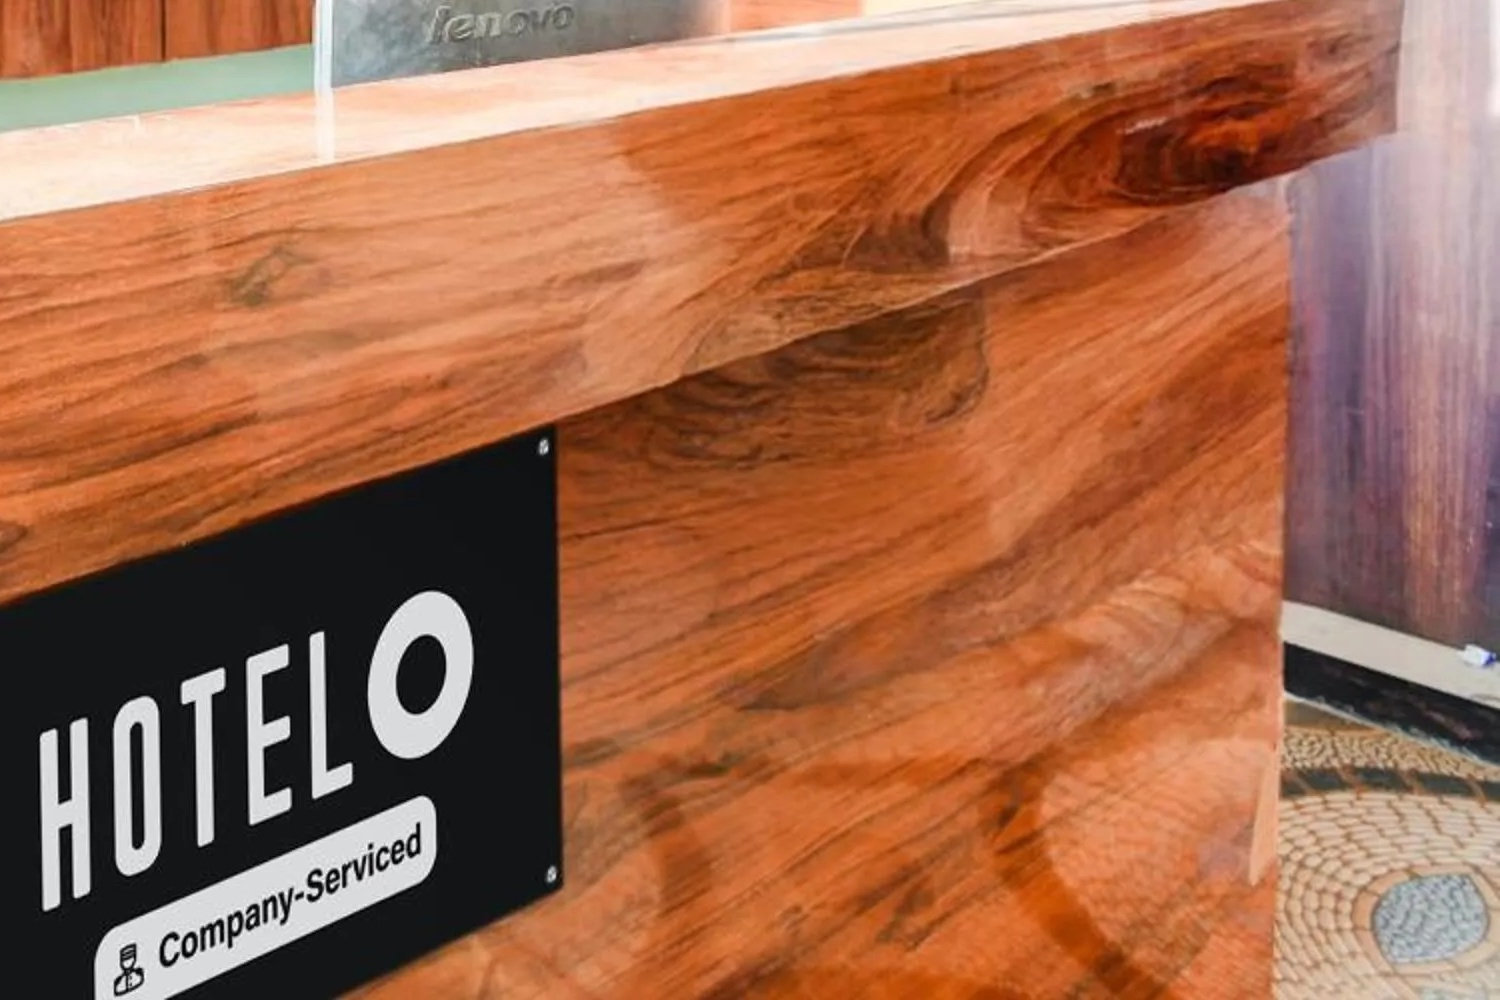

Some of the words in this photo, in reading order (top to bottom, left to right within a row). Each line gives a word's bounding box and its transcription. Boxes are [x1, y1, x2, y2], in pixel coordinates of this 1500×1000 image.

[428, 2, 575, 45] lenovo
[39, 631, 353, 912] HOTEL
[158, 823, 422, 968] Company-Serviced
